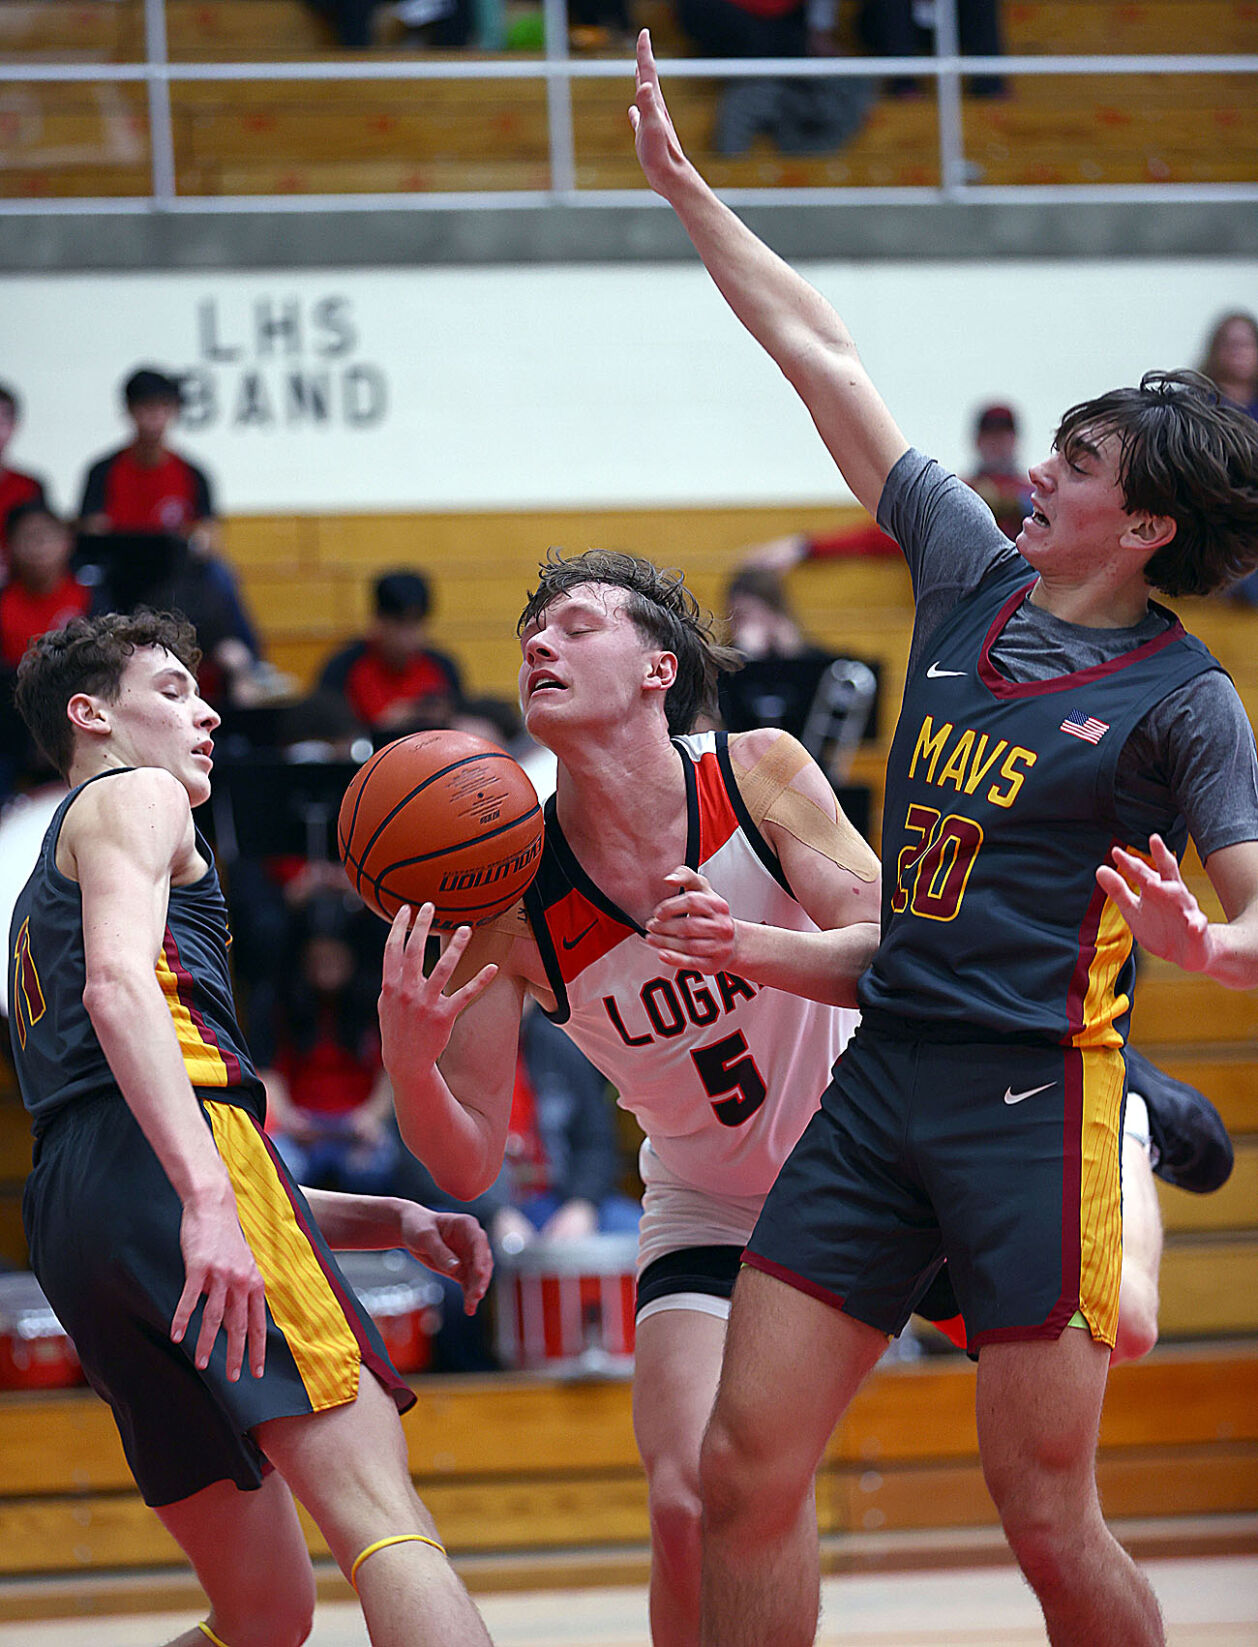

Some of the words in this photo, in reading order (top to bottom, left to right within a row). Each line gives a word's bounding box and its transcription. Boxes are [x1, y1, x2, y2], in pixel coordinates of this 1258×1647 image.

[198, 294, 358, 362] LHS
[907, 714, 1038, 809] MAVS
[890, 803, 984, 922] 20
[602, 967, 764, 1047] LOGA
[689, 1028, 767, 1128] 5
